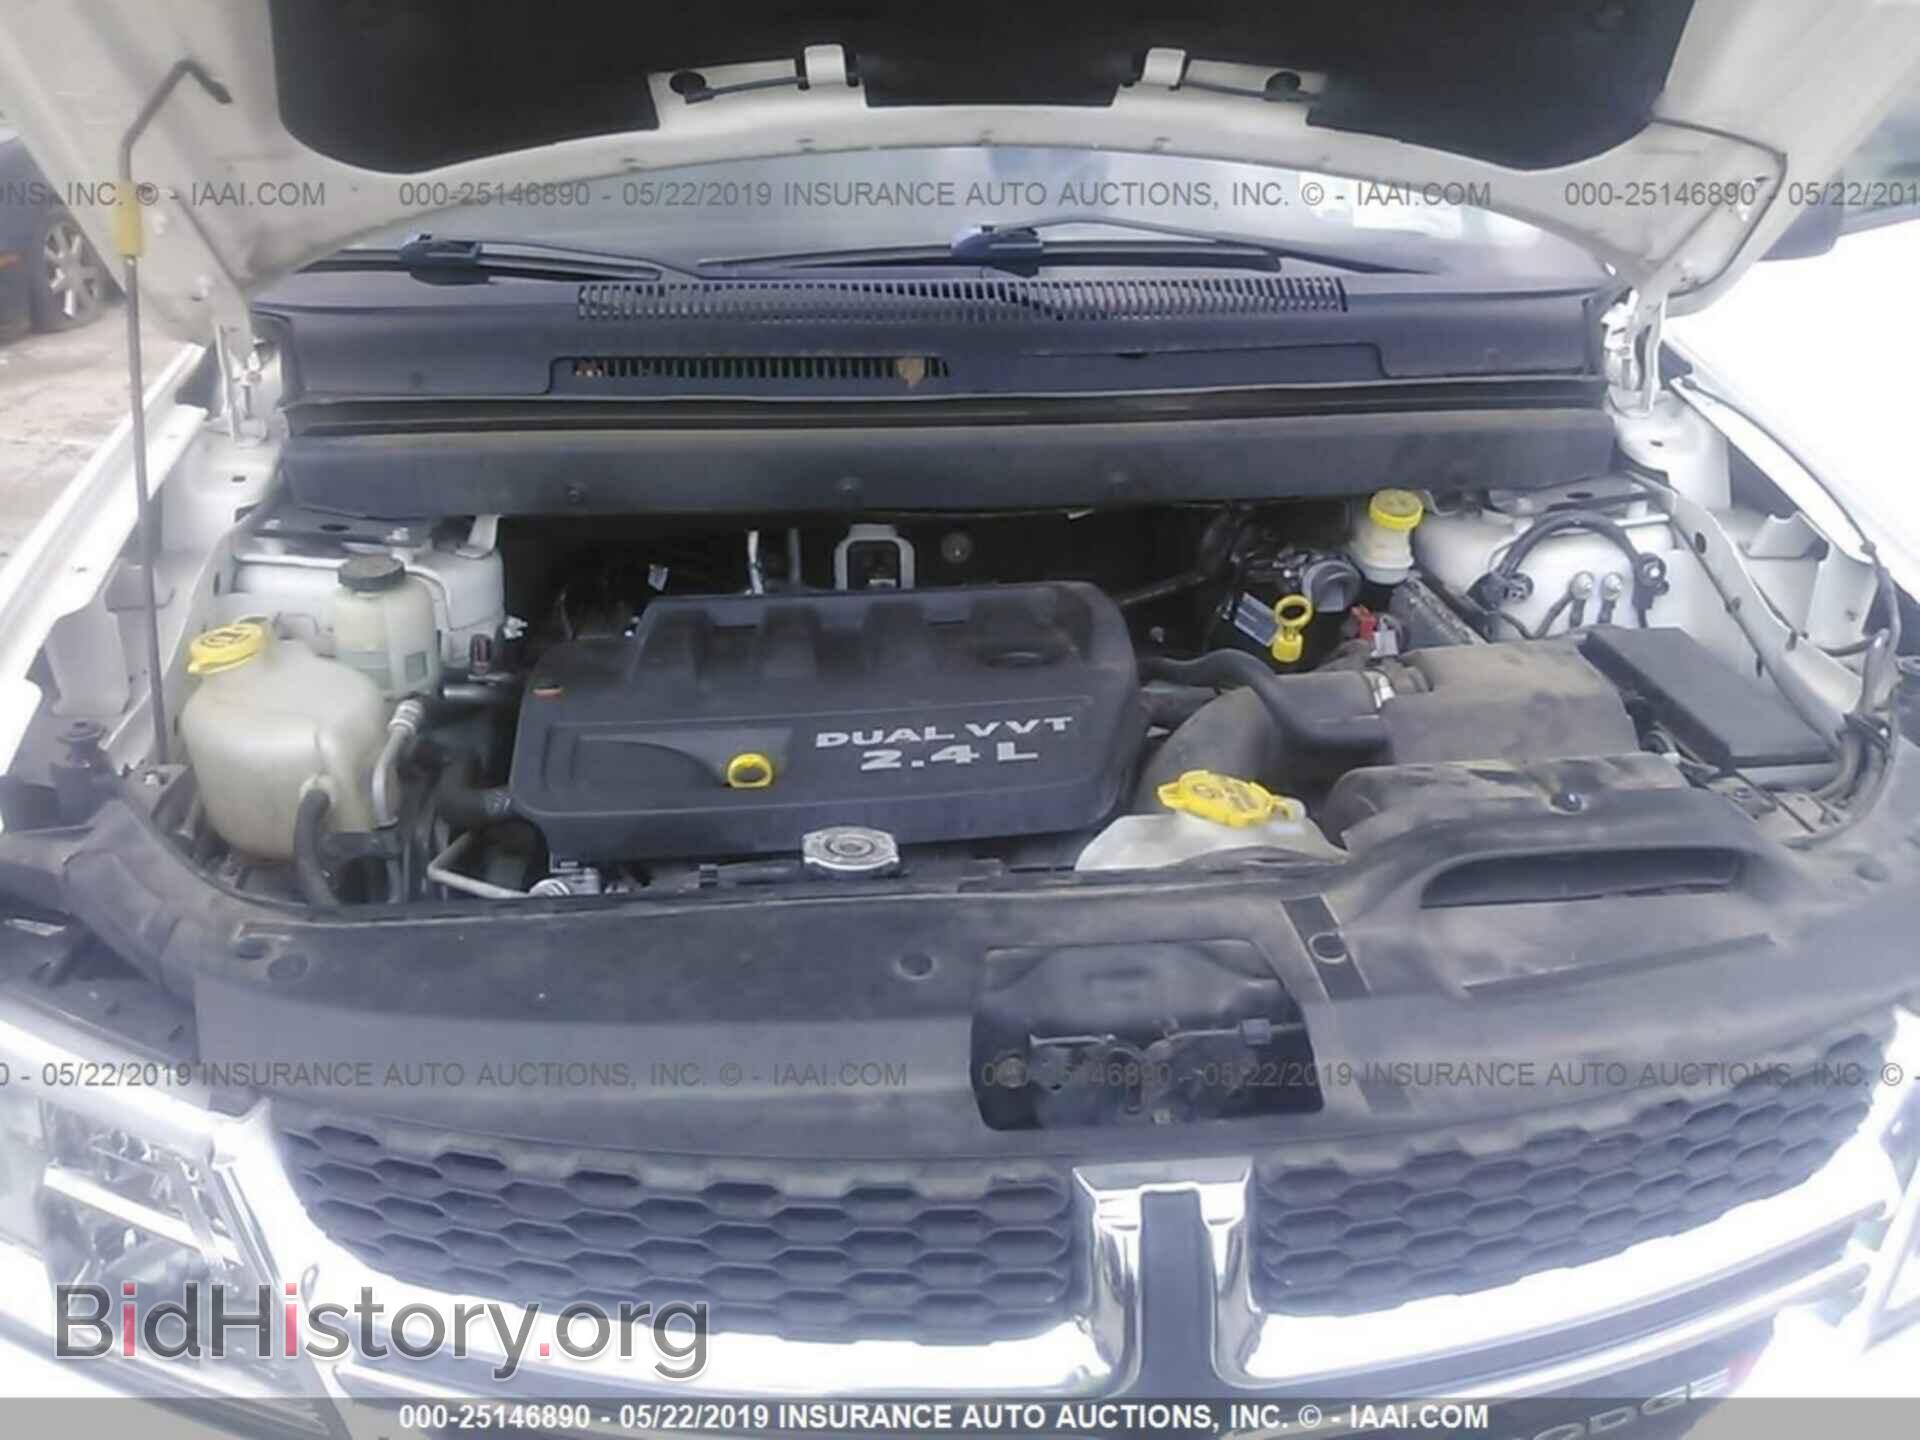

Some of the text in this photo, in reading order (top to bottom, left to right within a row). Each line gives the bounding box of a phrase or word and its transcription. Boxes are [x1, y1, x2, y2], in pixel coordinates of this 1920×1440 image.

[815, 717, 1073, 747] DUAL VVT
[1512, 1368, 1729, 1440] ODGE
